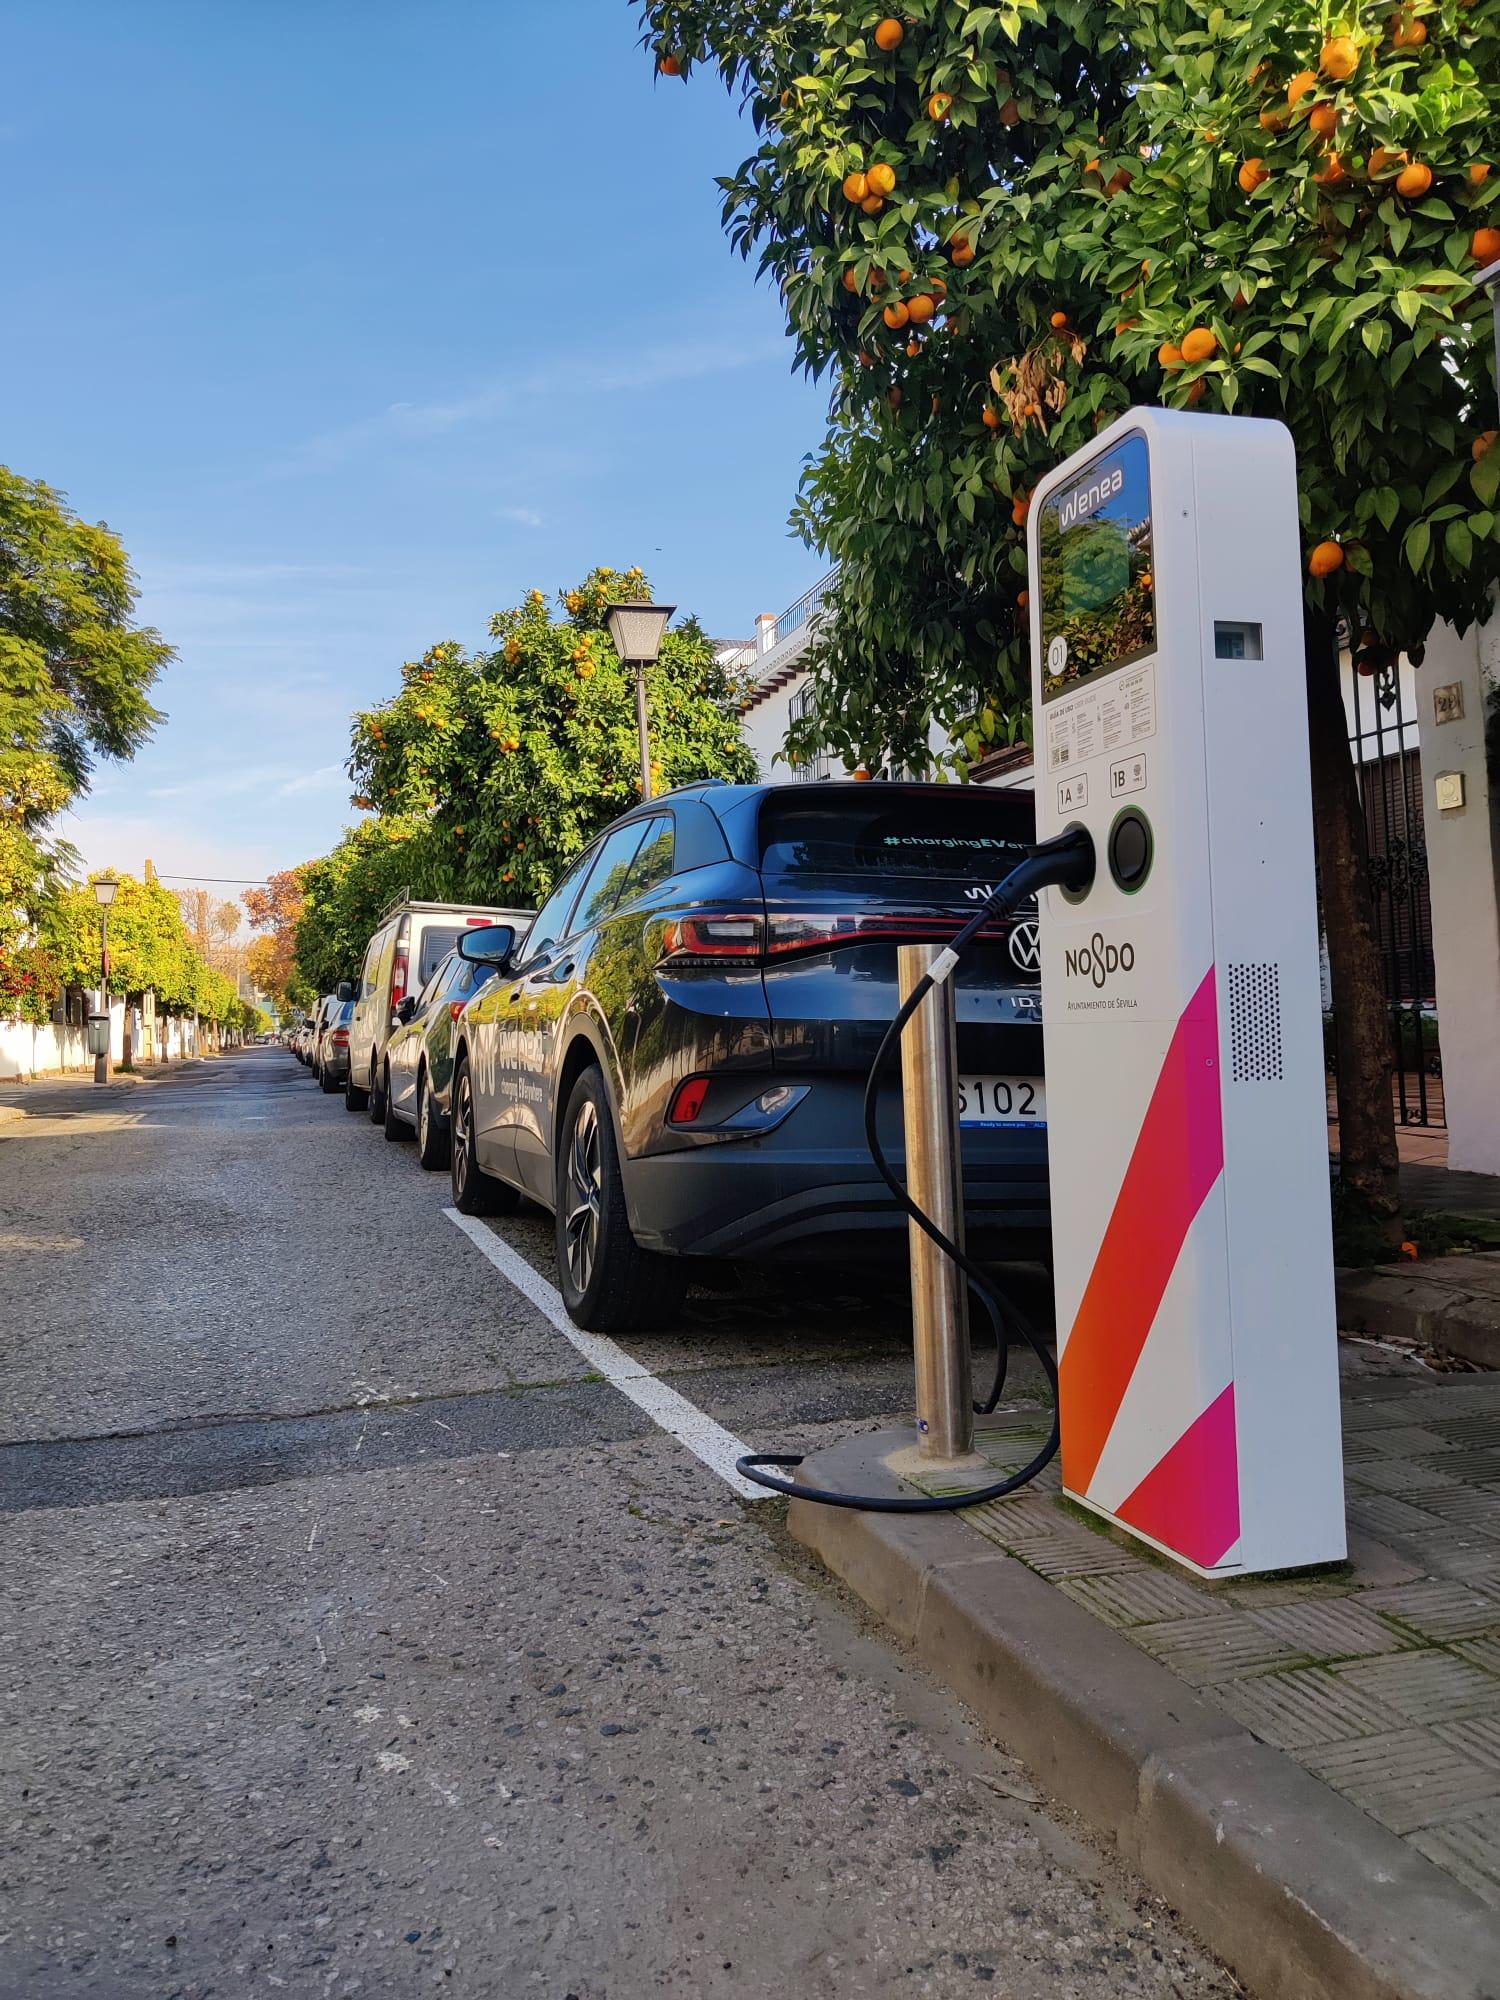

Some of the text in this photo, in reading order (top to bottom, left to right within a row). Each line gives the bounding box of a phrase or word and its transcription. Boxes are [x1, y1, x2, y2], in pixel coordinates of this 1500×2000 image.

[1061, 469, 1123, 527] Wenea
[1113, 770, 1126, 789] 1B
[1060, 788, 1072, 806] 1A
[883, 836, 1024, 850] #chargingEVer
